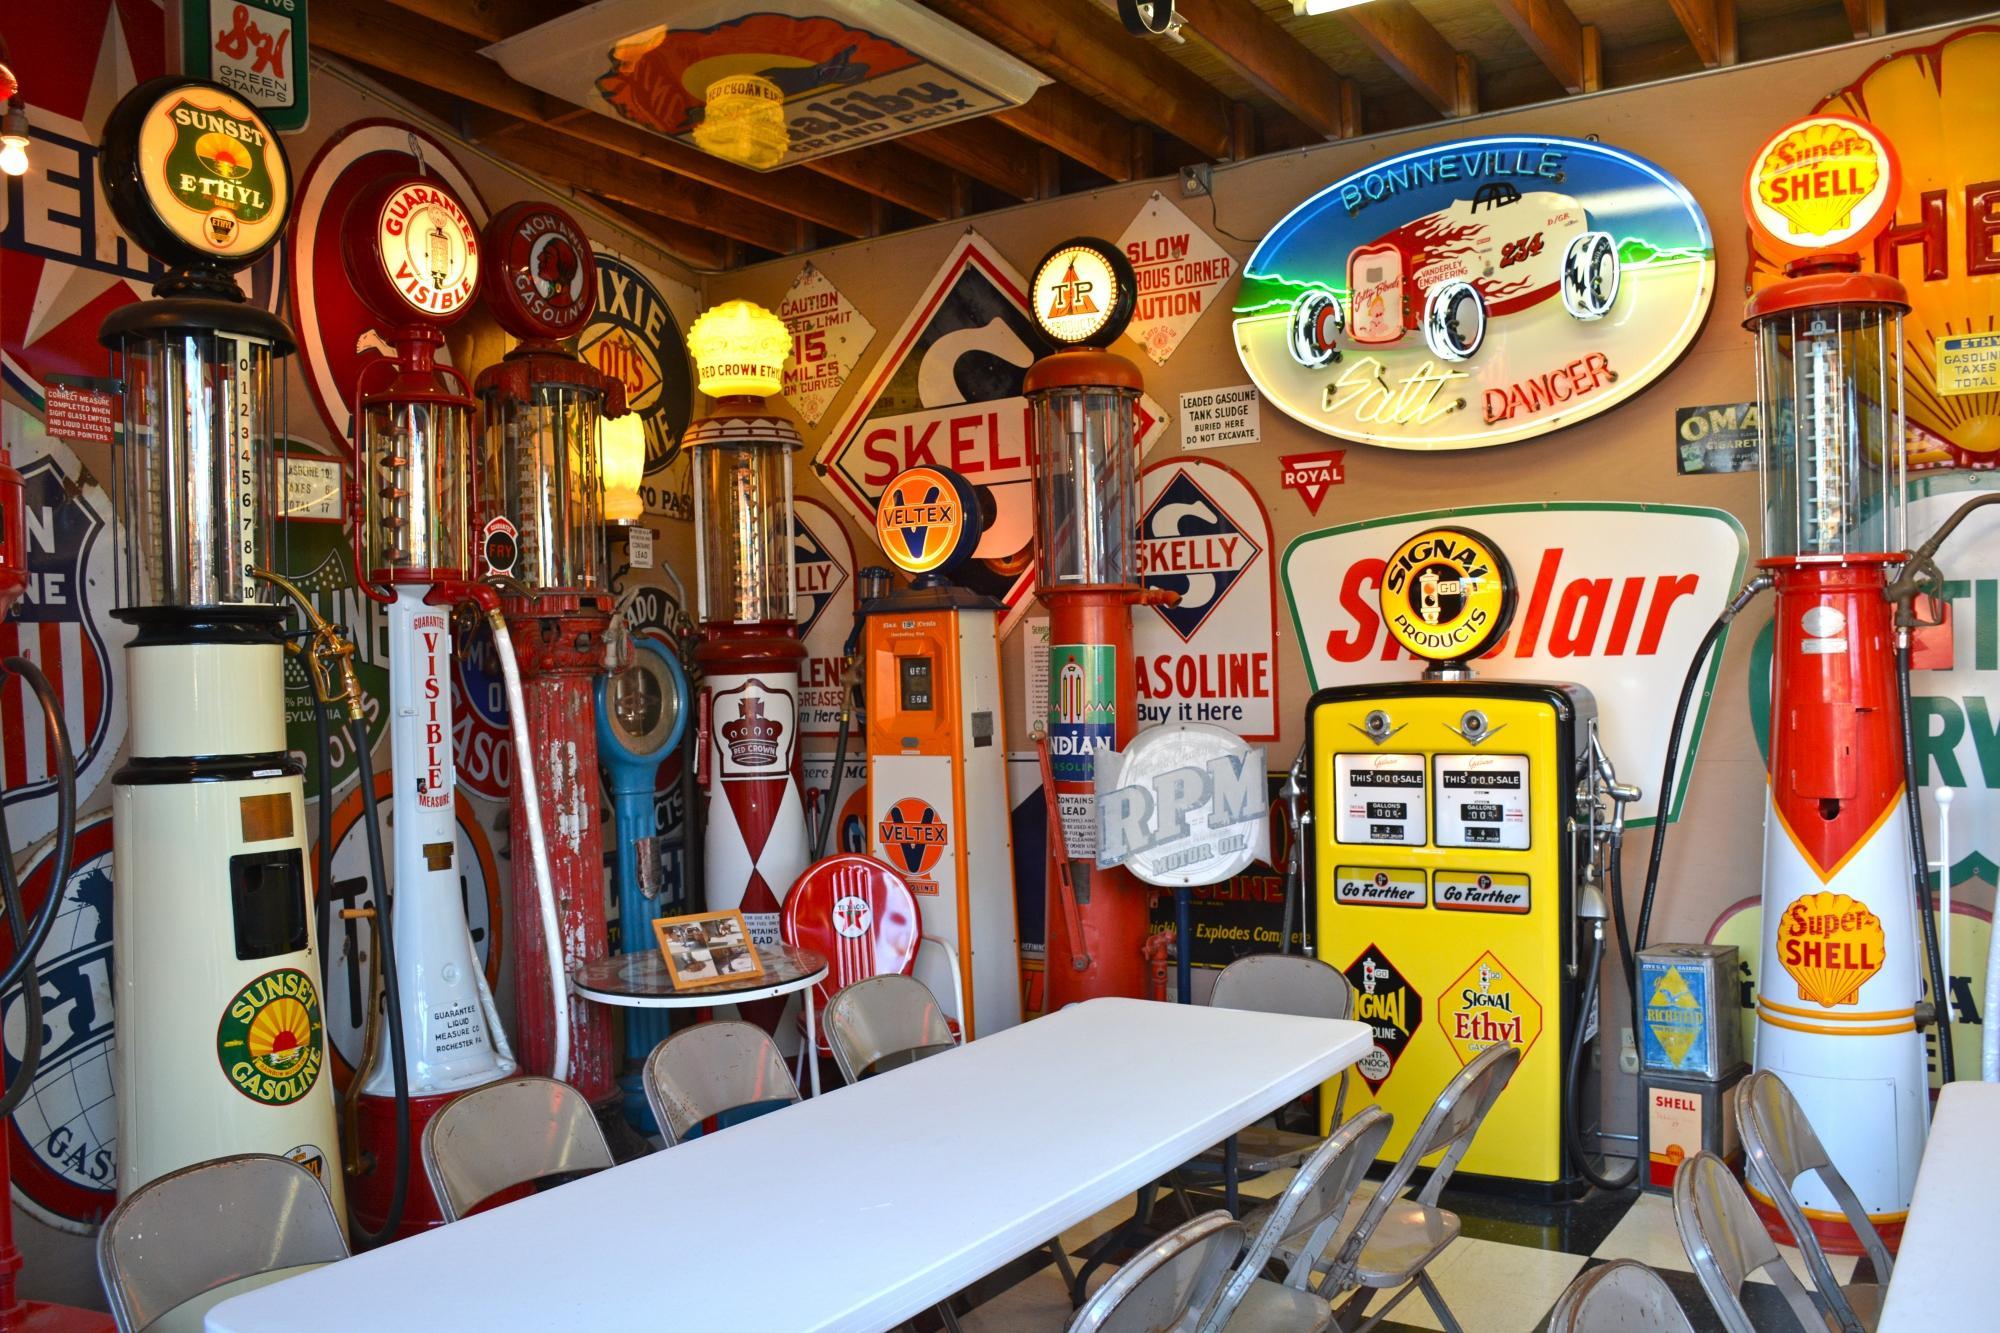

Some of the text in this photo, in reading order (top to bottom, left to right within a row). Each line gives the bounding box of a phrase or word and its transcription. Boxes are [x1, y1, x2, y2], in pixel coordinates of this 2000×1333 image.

[220, 65, 287, 92] GREEN
[220, 76, 287, 103] STAMPS
[175, 108, 263, 147] SUNSET
[788, 98, 976, 152] GRAND PRIX
[1340, 151, 1568, 210] BONNEVILLE
[1771, 168, 1865, 204] SHELL
[179, 173, 265, 209] ETHYL
[211, 216, 234, 229] ETHYL
[386, 188, 477, 256] GUARANTEE
[1126, 234, 1190, 264] SLOW
[1500, 232, 1544, 268] 234
[1174, 258, 1230, 286] CORNER
[1420, 260, 1463, 277] VANDERLEY
[395, 260, 472, 310] VISIBLE
[1418, 267, 1468, 288] ENGINEERING
[516, 274, 586, 324] GASOLINE
[782, 292, 838, 316] CAUTION
[816, 310, 852, 328] LIMIT
[794, 330, 827, 366] 15
[240, 359, 248, 370] 0
[702, 366, 716, 378] RED
[718, 364, 757, 376] CROWN
[783, 361, 840, 385] MILES
[1954, 362, 1996, 375] TAXES
[241, 382, 248, 394] 1
[784, 376, 841, 396] ON CURVES
[1323, 356, 1470, 425] Salt
[1482, 352, 1616, 425] DANCER
[1954, 376, 1996, 388] TOTAL
[48, 390, 110, 406] CORRECT MEASURE
[48, 400, 90, 412] COMPLETED
[1184, 390, 1256, 409] LEADED GASOLINE
[48, 410, 110, 424] SIGHT GLASS EMPTIES
[241, 404, 250, 416] 2
[1190, 405, 1248, 422] TANK SLUDGE
[50, 428, 76, 436] PROPER
[62, 420, 80, 428] LIQUID
[82, 423, 103, 432] LEVELS
[1194, 418, 1245, 432] BURIED HERE
[1680, 406, 1758, 442] OMA
[242, 427, 250, 439] 3
[1186, 428, 1254, 444] DO NOT EXCAVATE
[1706, 439, 1758, 450] CIGARET
[242, 450, 250, 462] 4
[242, 472, 250, 484] 5
[288, 464, 320, 478] ASOLINE
[1285, 468, 1342, 485] ROYAL
[288, 483, 312, 494] AXES
[242, 494, 250, 508] 6
[289, 500, 310, 512] OTAL
[244, 519, 251, 531] 7
[884, 506, 952, 528] VELTEX
[244, 541, 252, 554] 8
[244, 565, 252, 578] 9
[1387, 539, 1488, 596] SIGNAL
[244, 587, 254, 599] 10
[1440, 582, 1459, 594] GO
[627, 594, 657, 632] ADO
[414, 616, 445, 630] GUARANTEE
[1394, 606, 1488, 649] PRODUCTS
[424, 632, 442, 790] VISIBLE
[814, 710, 841, 722] Here
[1138, 702, 1243, 725] Buy it Here
[748, 744, 776, 756] CROWN
[418, 792, 450, 808] MEASURE
[1098, 750, 1268, 855] RPM
[1062, 806, 1086, 816] LEAD
[880, 825, 944, 842] VELTEX
[1153, 835, 1248, 876] MOTOR OIL
[1342, 882, 1415, 900] Go Farther
[1444, 886, 1520, 904] Go Farther
[752, 936, 772, 944] EAD
[1196, 924, 1250, 944] Explodes
[1786, 940, 1875, 970] SHELL
[1376, 970, 1388, 978] GO
[232, 972, 319, 1025] SUNSET
[1462, 990, 1512, 1013] SIGNAL
[434, 1004, 476, 1020] GUARANTEE
[1353, 986, 1410, 1036] IGNAL
[447, 1017, 470, 1029] LIQUID
[1454, 1011, 1523, 1043] Ethyl
[434, 1024, 480, 1041] MEASURE CO
[436, 1039, 474, 1052] ROCHESTER
[1358, 1058, 1388, 1068] KNOCK
[232, 1048, 322, 1101] GASOLINE
[1656, 1096, 1696, 1112] SHELL
